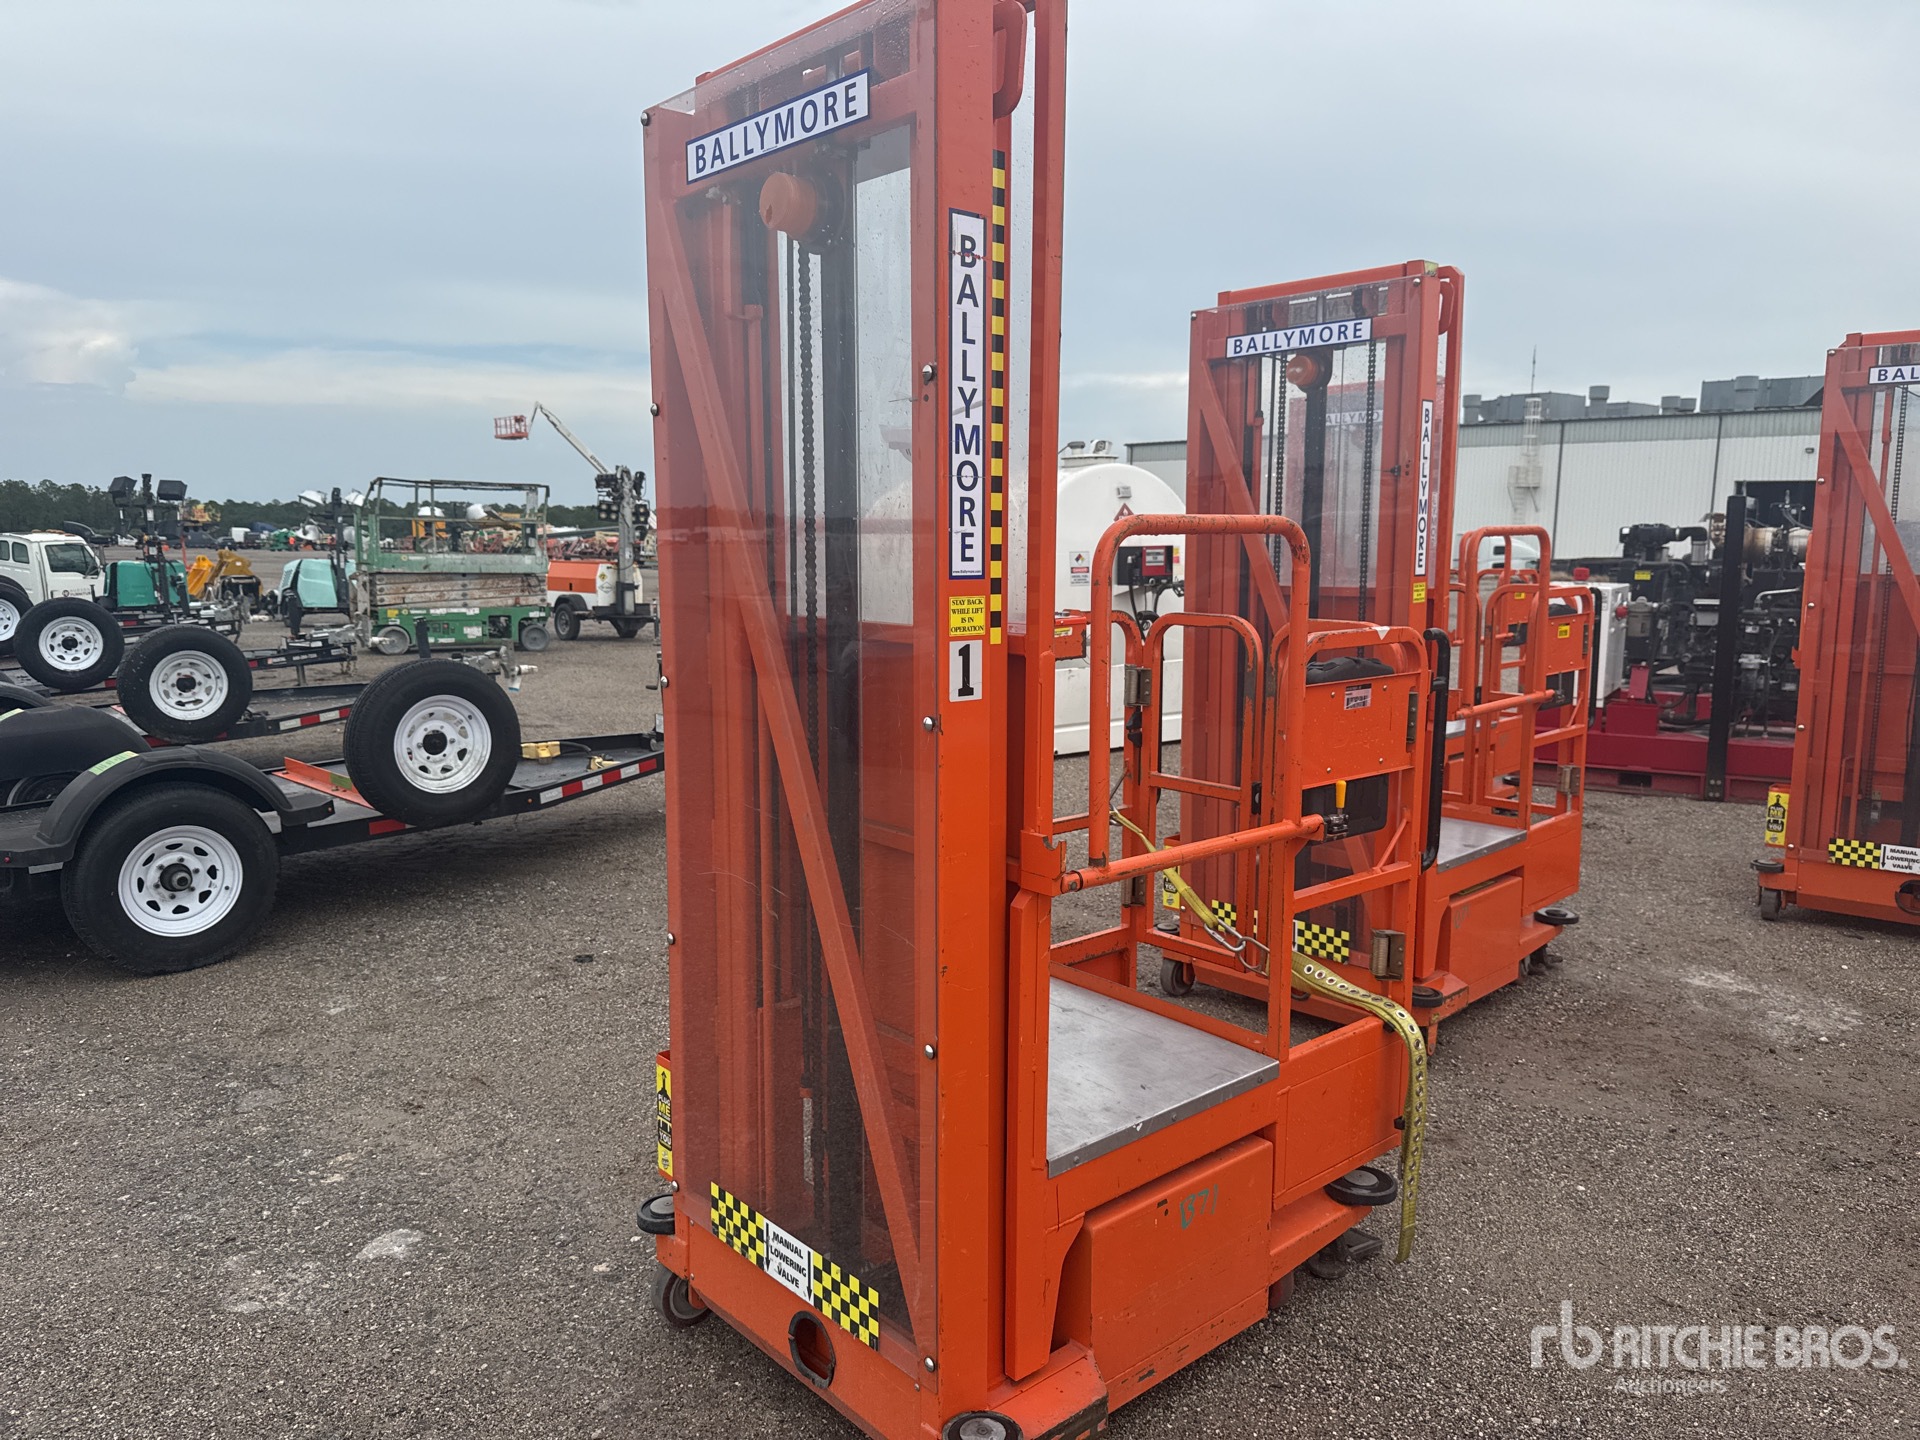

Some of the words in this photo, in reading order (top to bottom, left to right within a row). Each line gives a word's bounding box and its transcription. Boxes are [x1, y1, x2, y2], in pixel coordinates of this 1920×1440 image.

[694, 81, 858, 175] BALLYMORE
[1233, 321, 1363, 355] BALLYMORE
[1877, 366, 1920, 382] BAL
[954, 233, 981, 563] BALLYMORE
[1417, 408, 1431, 569] BALLYMORE
[951, 625, 984, 633] OPERATION
[957, 643, 975, 698] 1
[1768, 823, 1782, 832] YOU
[1889, 848, 1918, 856] MANUAL
[1892, 863, 1913, 871] VALVE
[658, 1093, 671, 1108] PLUG
[658, 1101, 671, 1118] ME
[659, 1131, 672, 1146] YOU
[772, 1231, 803, 1260] MANUAL
[770, 1245, 807, 1278] LOWERING
[776, 1265, 800, 1289] VALVE
